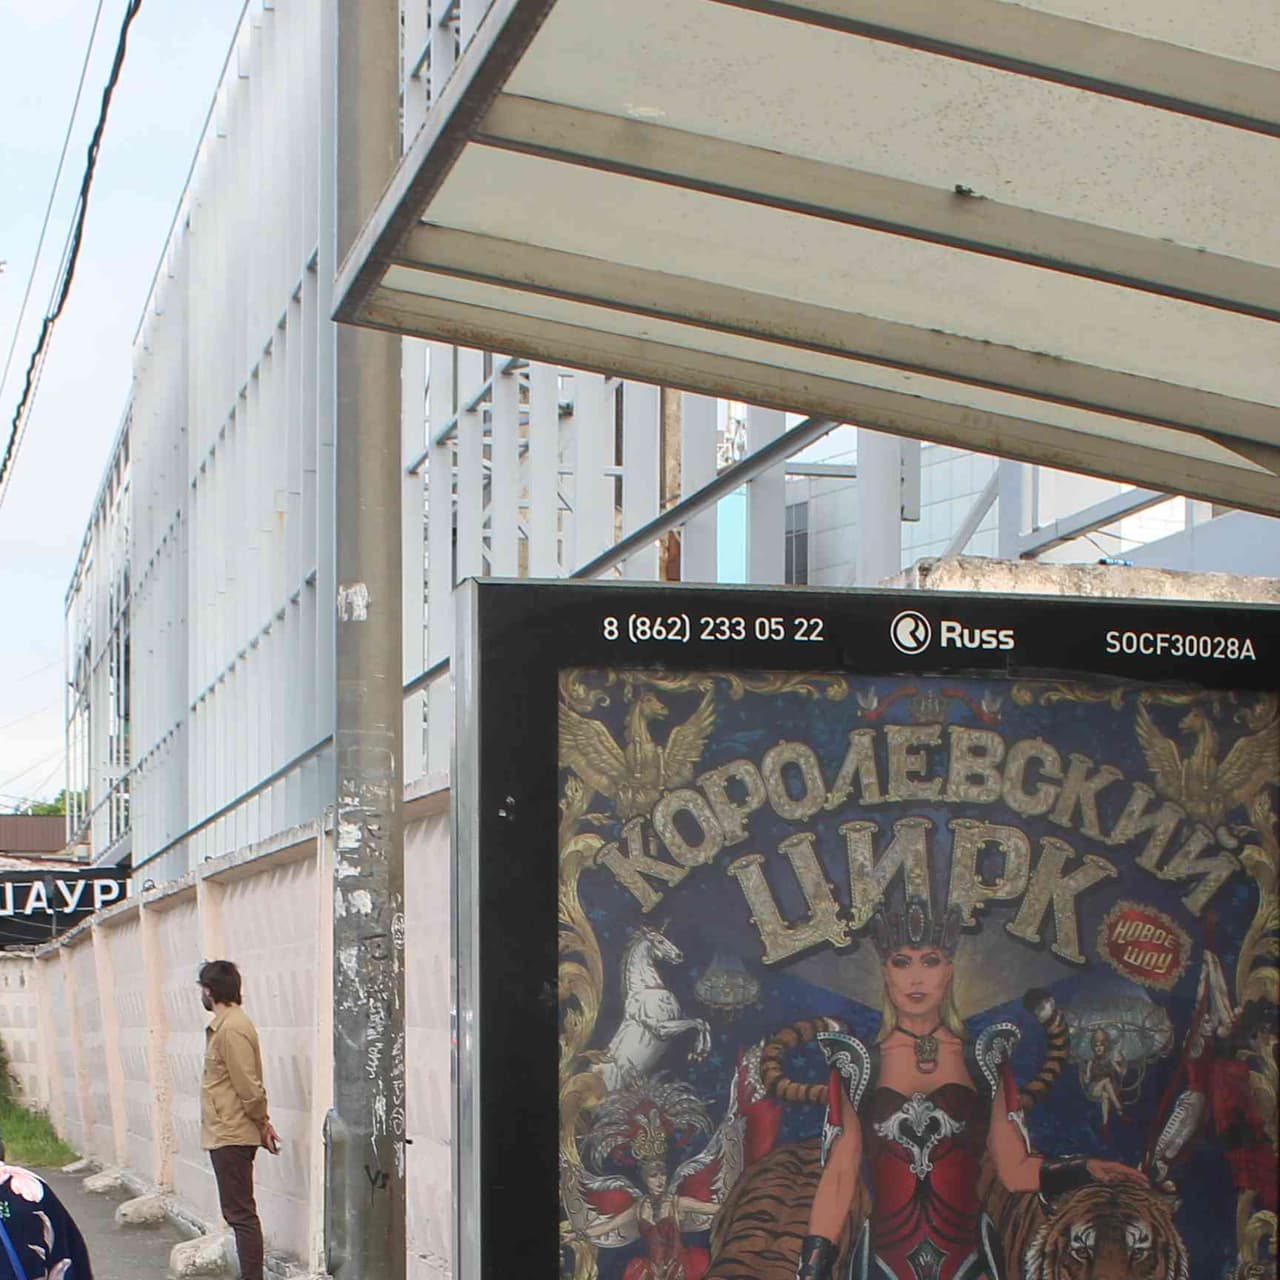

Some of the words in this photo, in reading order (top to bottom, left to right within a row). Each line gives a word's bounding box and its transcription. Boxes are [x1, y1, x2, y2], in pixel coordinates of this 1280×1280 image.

[603, 617, 619, 640] 8
[628, 614, 691, 643] (862)
[700, 617, 746, 640] 233
[755, 617, 785, 640] 05
[794, 618, 824, 641] 22
[940, 621, 1015, 650] Russ
[1105, 631, 1256, 660] SOCF30028A
[594, 722, 1243, 915] КОРОЛЕВСКИЙ
[726, 817, 1118, 967] ЦИРК
[1112, 920, 1177, 949] НОВОЕ
[1124, 946, 1173, 973] ШОУ
